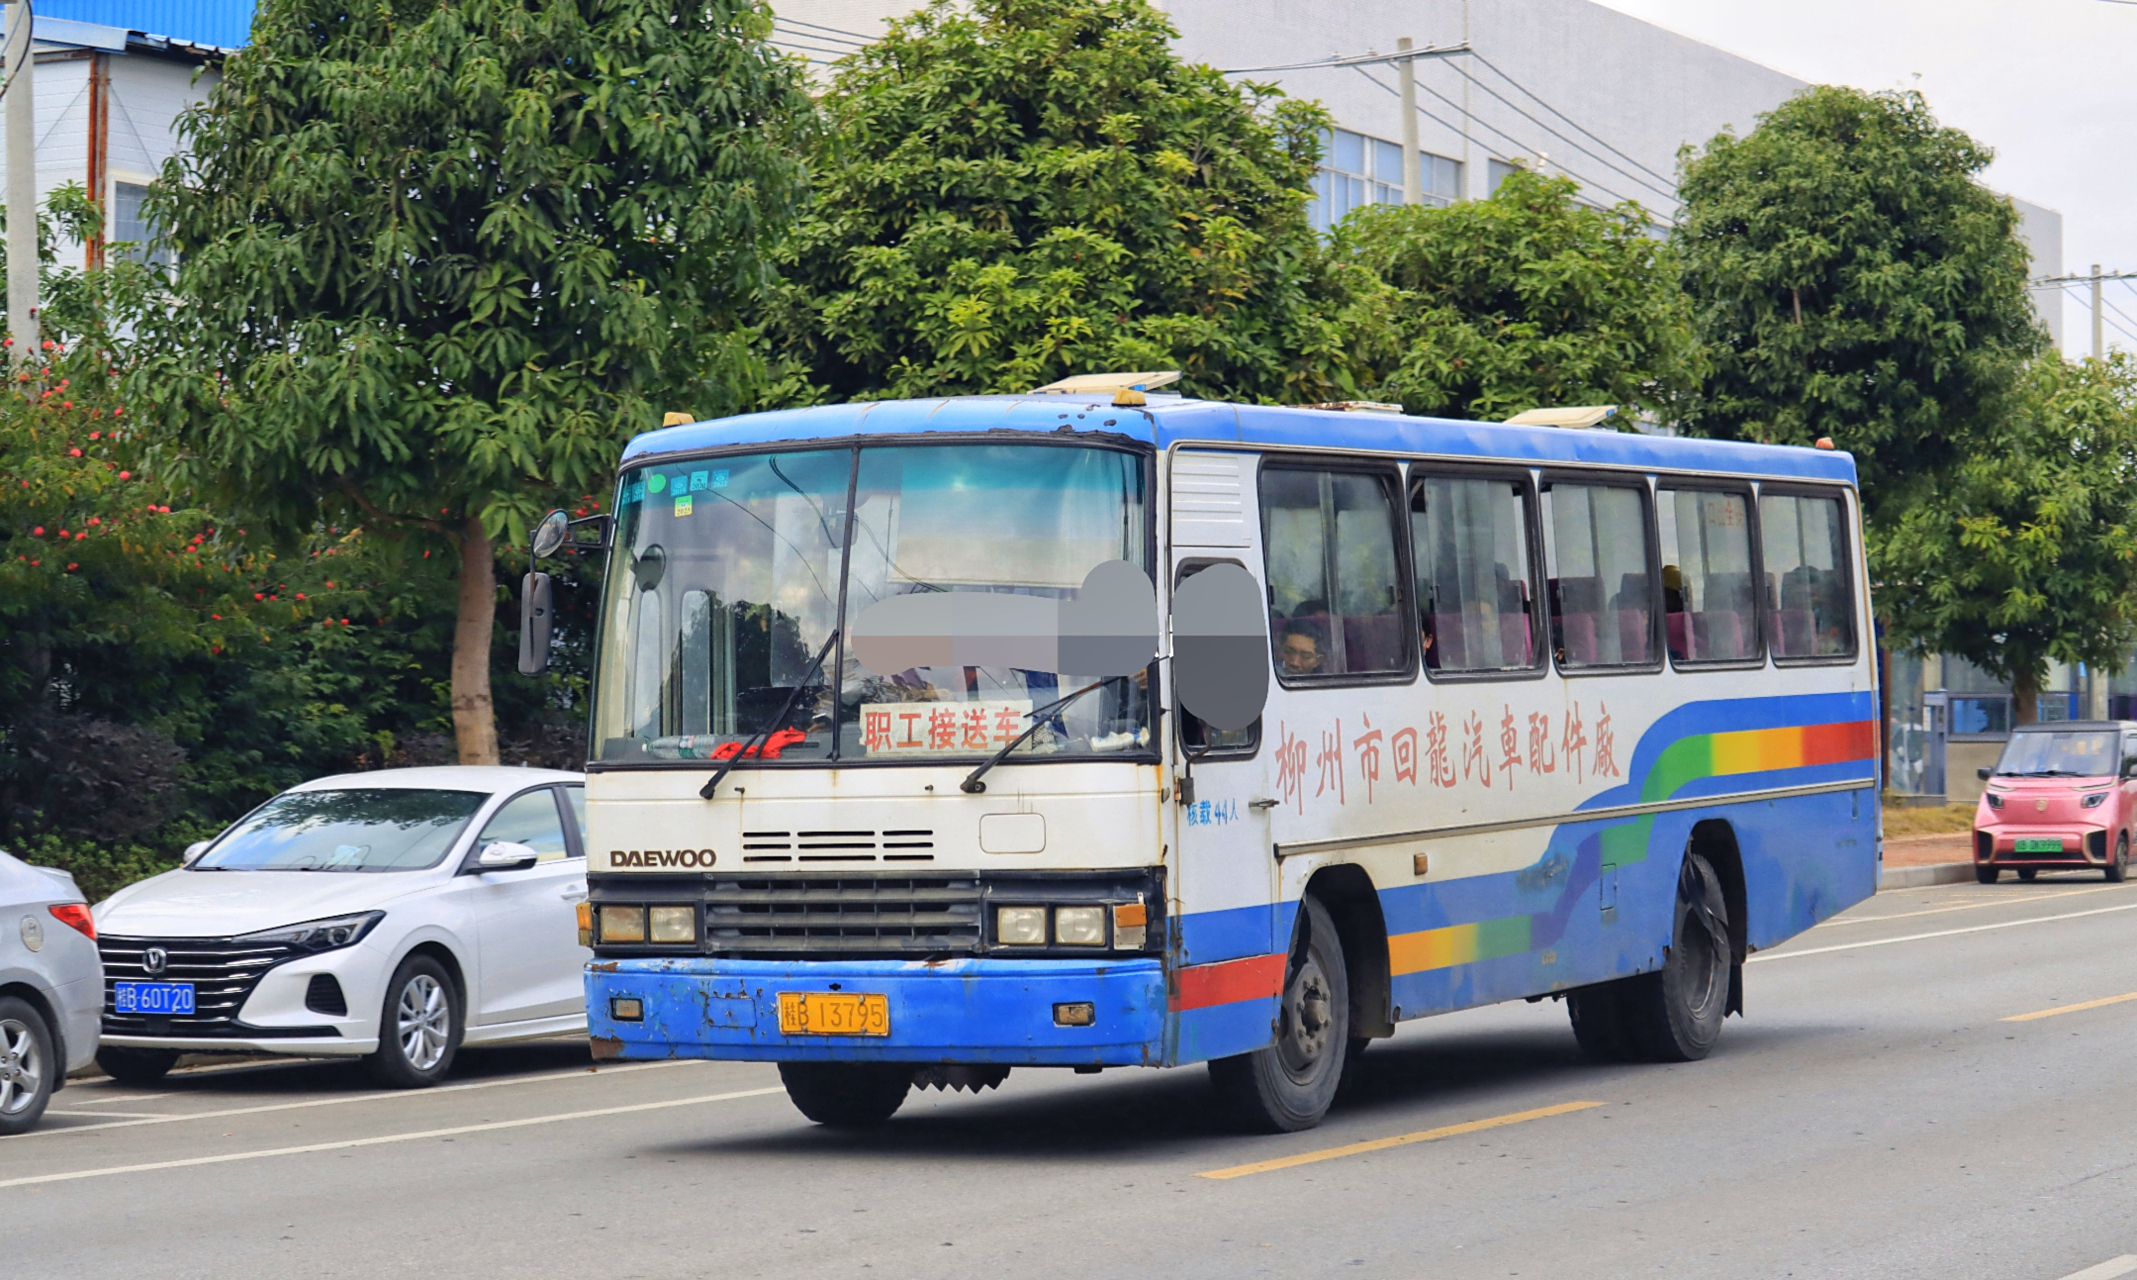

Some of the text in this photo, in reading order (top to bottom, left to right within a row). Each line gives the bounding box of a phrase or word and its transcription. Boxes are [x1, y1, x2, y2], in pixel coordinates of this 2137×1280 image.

[865, 707, 1021, 752] 职工接送车
[610, 849, 717, 868] DAEWOO
